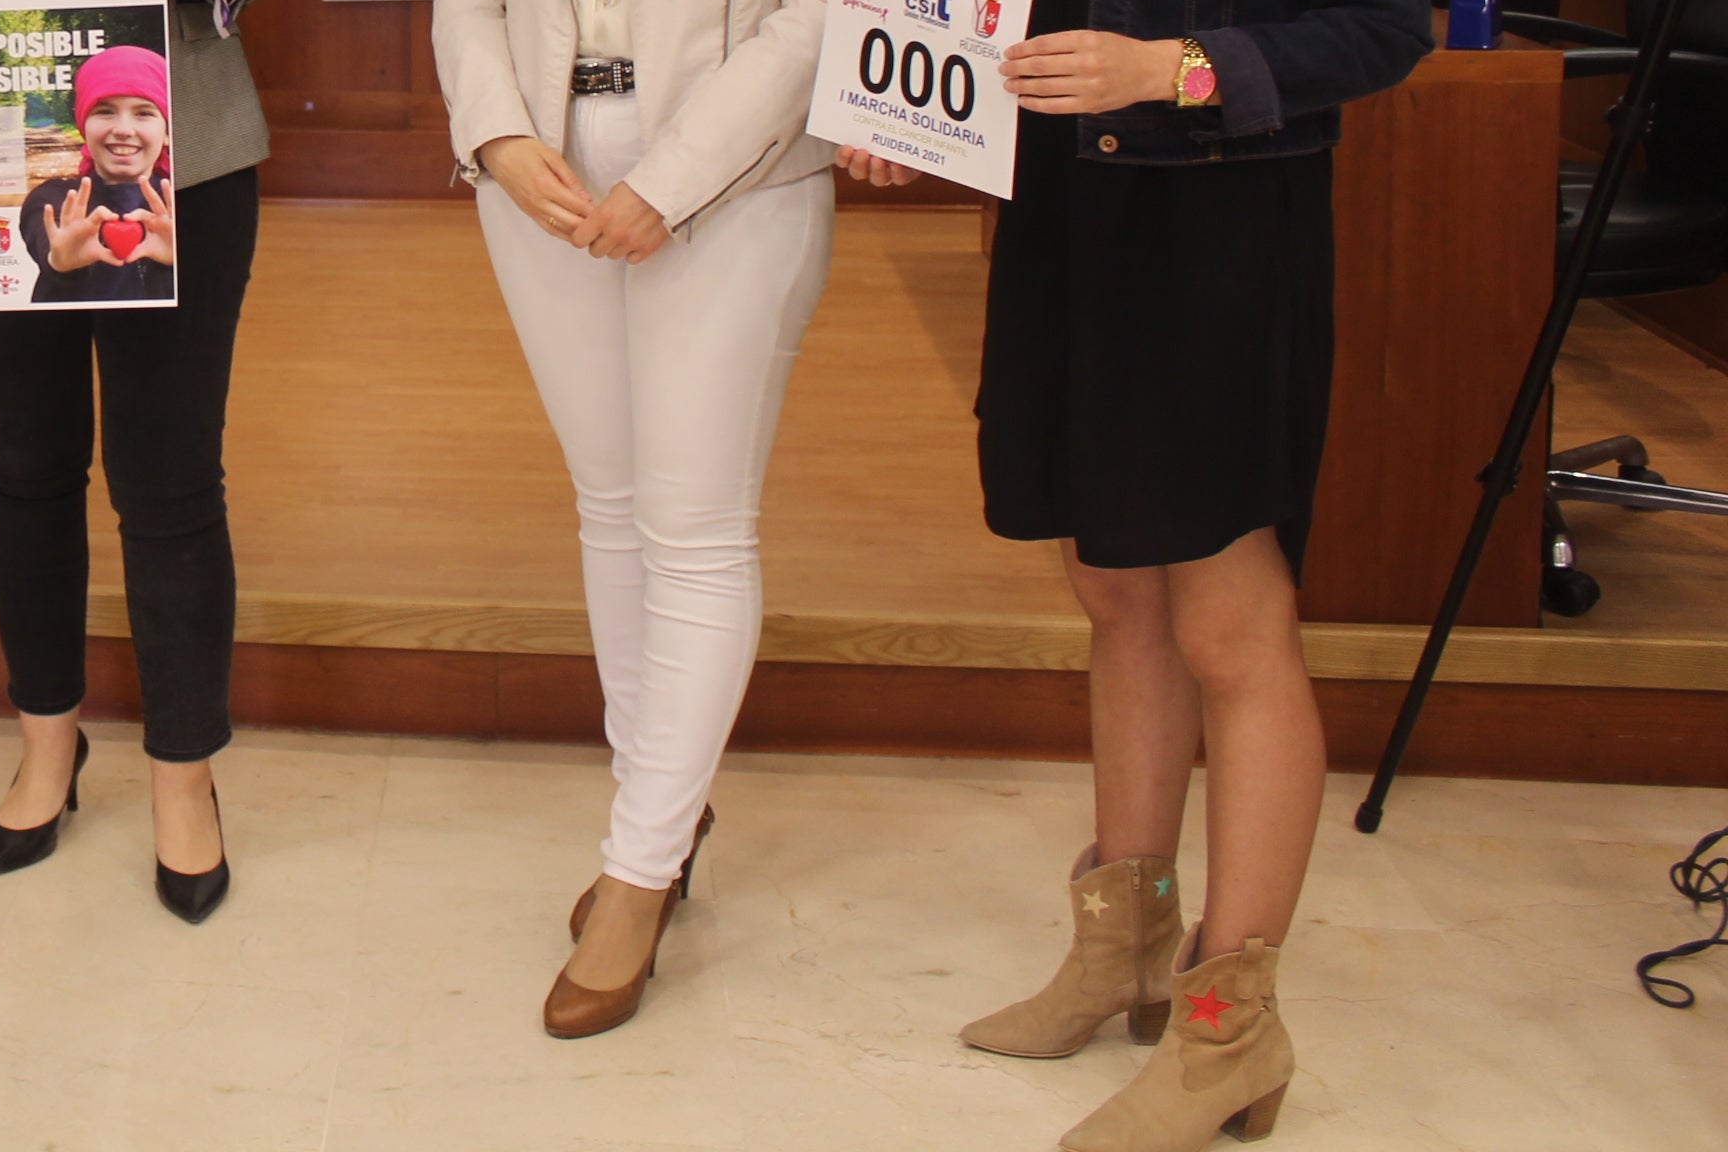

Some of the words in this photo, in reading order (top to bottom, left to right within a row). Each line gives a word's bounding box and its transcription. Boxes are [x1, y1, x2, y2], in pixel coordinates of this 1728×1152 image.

[959, 39, 1002, 61] RUIDERA
[859, 27, 976, 122] 000
[839, 89, 845, 102] I
[847, 91, 907, 122] MARCHA
[911, 112, 985, 148] SOLIDARIA
[852, 113, 887, 131] CONTRA
[886, 124, 897, 134] EL
[931, 136, 968, 158] INFANTIL
[872, 133, 920, 157] RUIDERA
[922, 149, 945, 165] 2021
